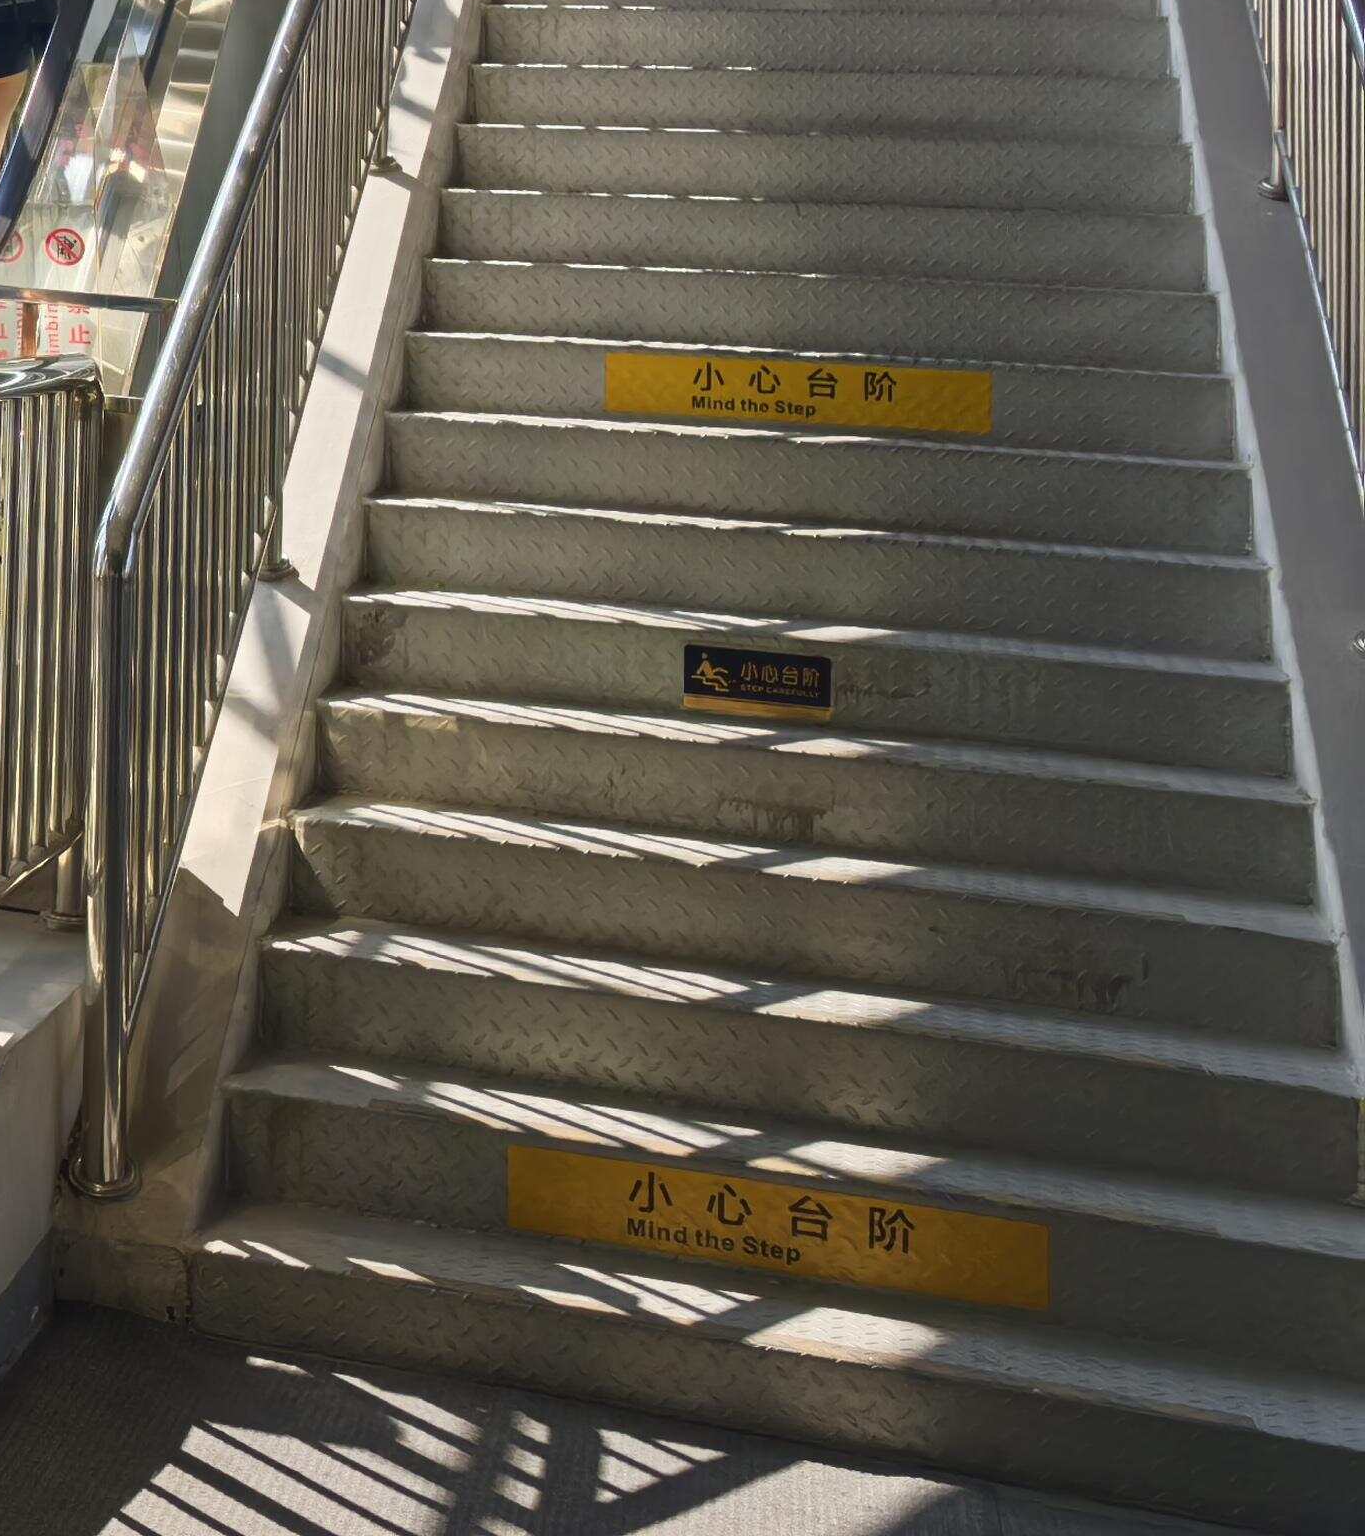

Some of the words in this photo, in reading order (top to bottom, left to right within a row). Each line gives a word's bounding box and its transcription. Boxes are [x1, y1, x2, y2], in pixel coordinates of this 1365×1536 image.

[692, 361, 898, 404] 小心台阶
[691, 395, 735, 413] Mind
[739, 397, 770, 415] the
[774, 399, 817, 418] Step
[740, 661, 820, 688] 小心台阶
[628, 1171, 917, 1255] 小心台阶
[626, 1218, 688, 1247] Mind
[695, 1229, 735, 1253] the
[742, 1235, 801, 1265] Step
